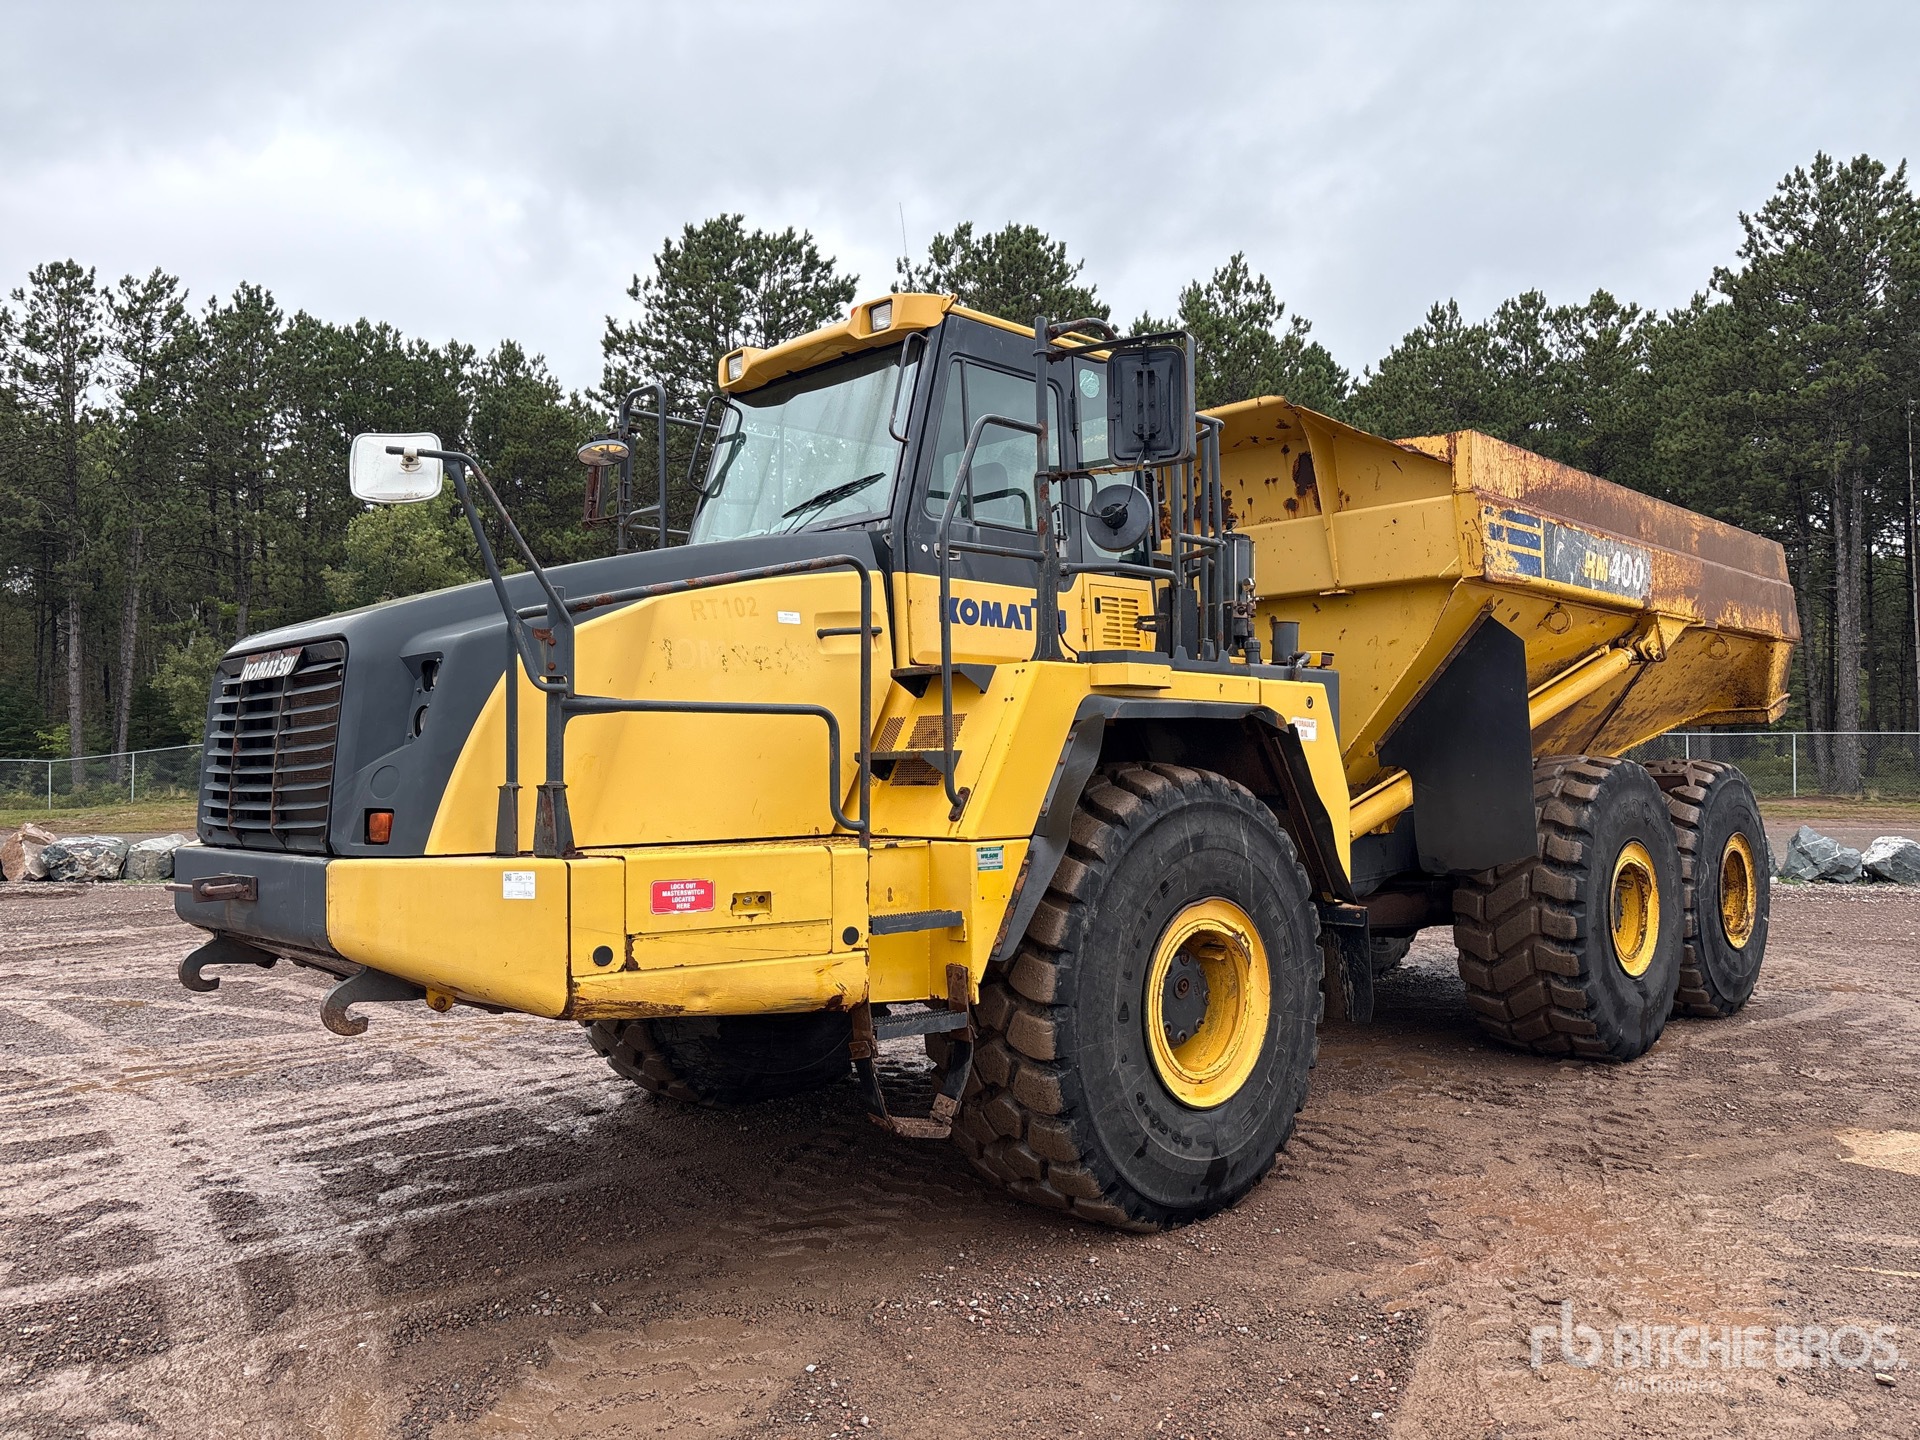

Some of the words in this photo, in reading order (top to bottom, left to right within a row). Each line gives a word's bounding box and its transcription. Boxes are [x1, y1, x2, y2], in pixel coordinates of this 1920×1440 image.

[690, 596, 760, 621] RT102
[240, 653, 297, 681] KOMATSU
[671, 895, 696, 903] LOCATED
